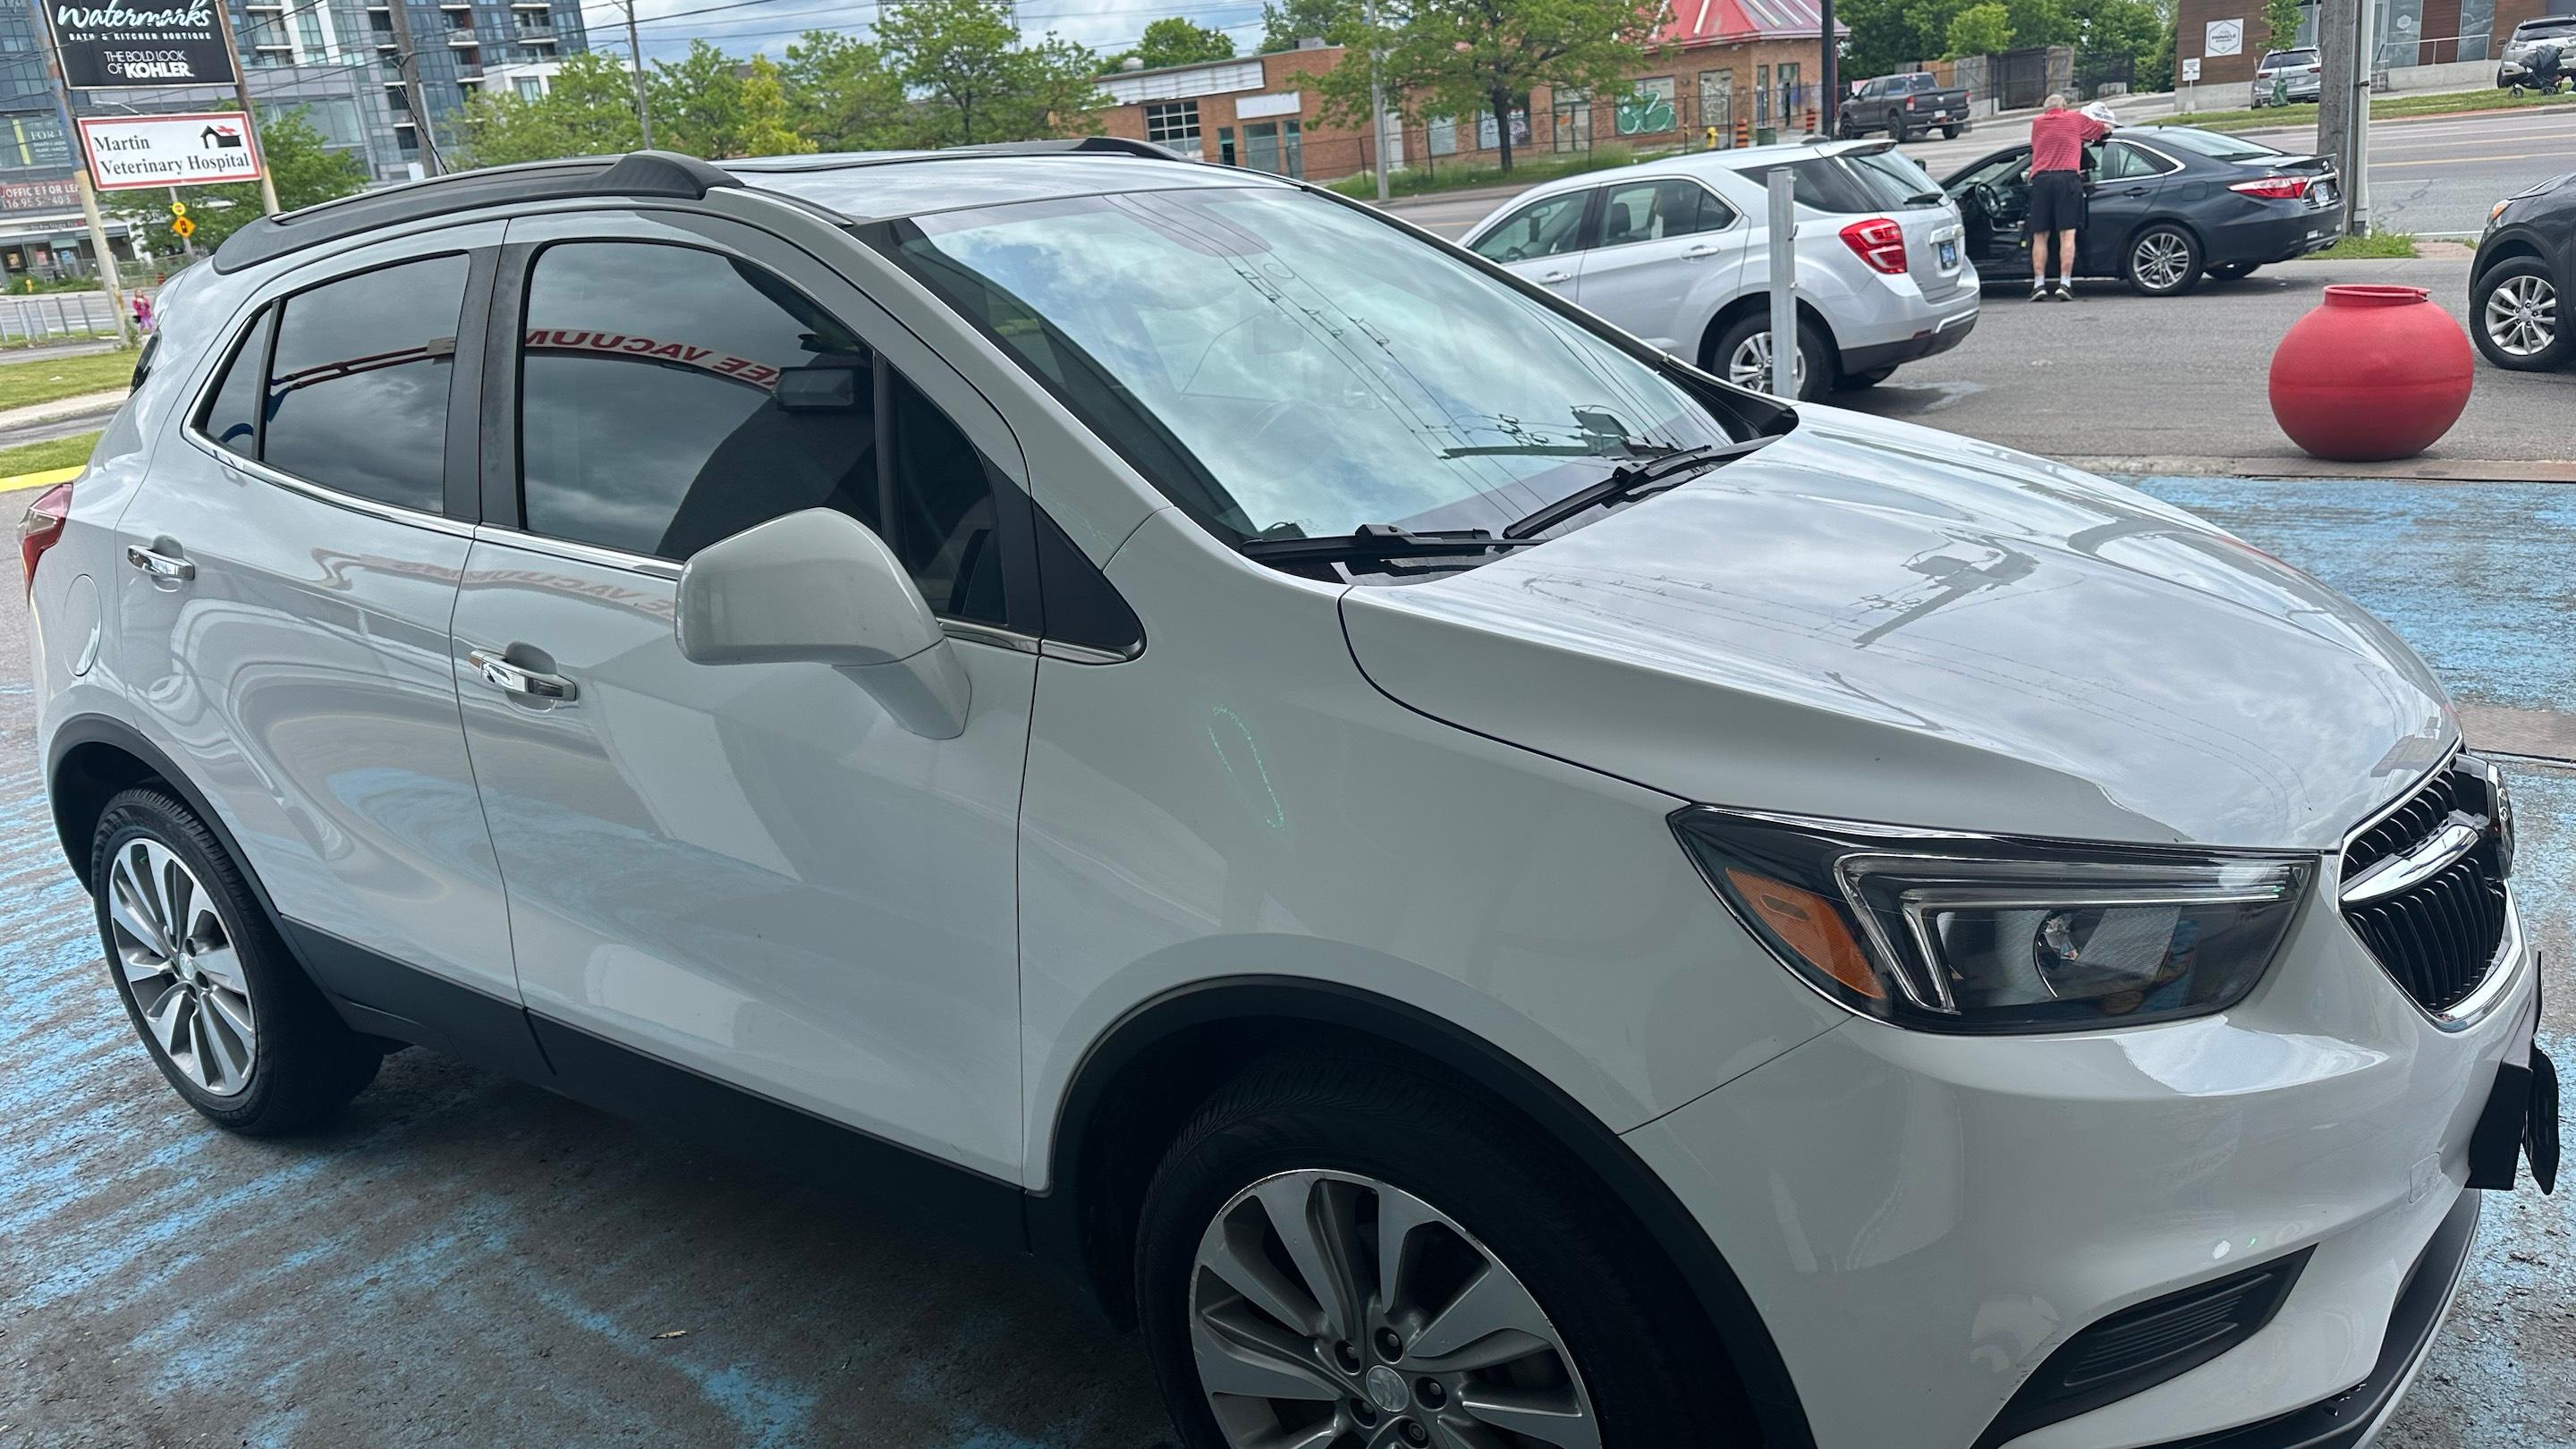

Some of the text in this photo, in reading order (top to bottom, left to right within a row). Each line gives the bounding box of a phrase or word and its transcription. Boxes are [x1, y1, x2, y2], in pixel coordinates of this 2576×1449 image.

[57, 0, 212, 29] Watermarks
[69, 33, 95, 41] BATH
[114, 32, 158, 41] KITCHEN
[163, 32, 212, 40] BOUTIQUE
[104, 50, 186, 63] THE BOLD LOOK
[107, 64, 123, 75] OF
[93, 135, 150, 152] Martin
[100, 153, 250, 175] Veterinary Hospital
